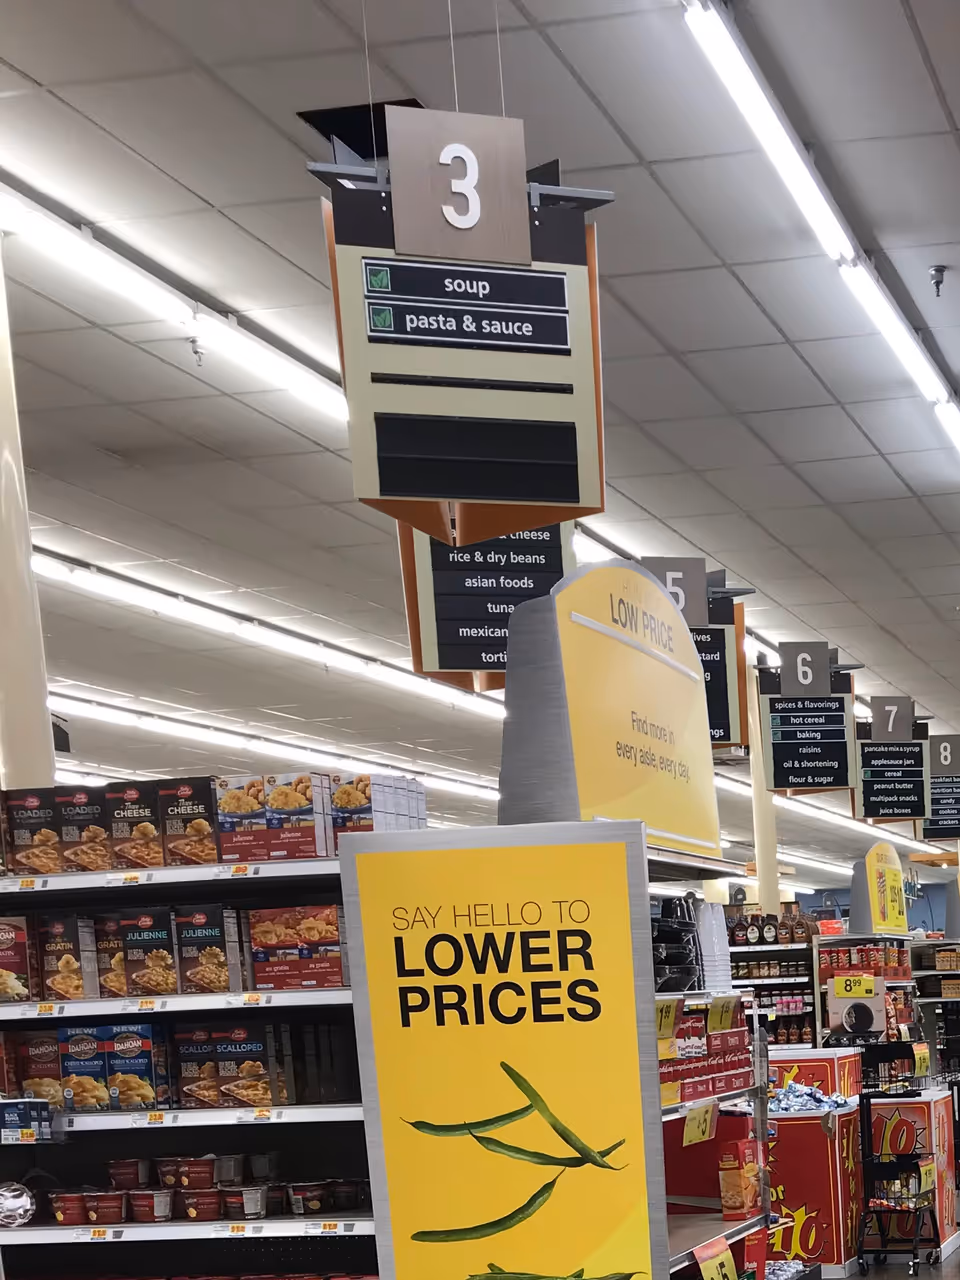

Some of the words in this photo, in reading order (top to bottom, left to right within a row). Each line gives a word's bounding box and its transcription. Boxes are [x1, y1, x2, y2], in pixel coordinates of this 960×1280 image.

[439, 143, 481, 229] 3
[444, 278, 490, 298] soup
[405, 313, 457, 331] pasta
[462, 315, 477, 332] &
[482, 319, 533, 336] sauce
[449, 550, 470, 562] rice
[474, 551, 484, 562] &
[487, 551, 507, 565] dry
[510, 552, 546, 564] beans
[464, 576, 496, 587] asian
[500, 576, 534, 588] foods
[666, 571, 686, 610] 5
[487, 602, 515, 613] tuna
[609, 592, 638, 634] LOW
[642, 610, 674, 653] PRICE
[459, 626, 509, 637] mexican
[796, 653, 813, 685] 6
[775, 701, 796, 709] spices
[804, 700, 839, 709] flavorings
[790, 716, 803, 724] hot
[803, 716, 825, 724] cereal
[884, 705, 898, 732] 7
[631, 711, 649, 735] Find
[649, 718, 668, 743] more
[667, 729, 675, 745] in
[796, 731, 821, 739] baking
[939, 742, 951, 765] 8
[616, 741, 638, 767] every
[659, 754, 678, 779] every
[783, 760, 793, 768] oil
[793, 760, 800, 768] &
[801, 760, 838, 769] shortening
[788, 775, 806, 783] flour
[814, 776, 834, 784] sugar
[873, 782, 894, 790] peanut
[13, 809, 53, 819] LOADED
[61, 805, 101, 815] LOADED
[114, 808, 152, 818] CHEESE
[168, 805, 206, 815] CHEESE
[393, 905, 443, 932] SAY
[453, 902, 542, 929] HELLO
[552, 900, 590, 924] TO
[126, 930, 168, 941] JULIENNE
[181, 927, 221, 938] JULIENNE
[45, 941, 74, 951] GRATIN
[394, 930, 593, 977] LOWER
[398, 979, 602, 1028] PRICES
[29, 1044, 58, 1056] IDAHOAN
[68, 1041, 98, 1054] IDAHOAN
[114, 1039, 143, 1051] IDAHOAN
[216, 1043, 263, 1053] SCALLOPED
